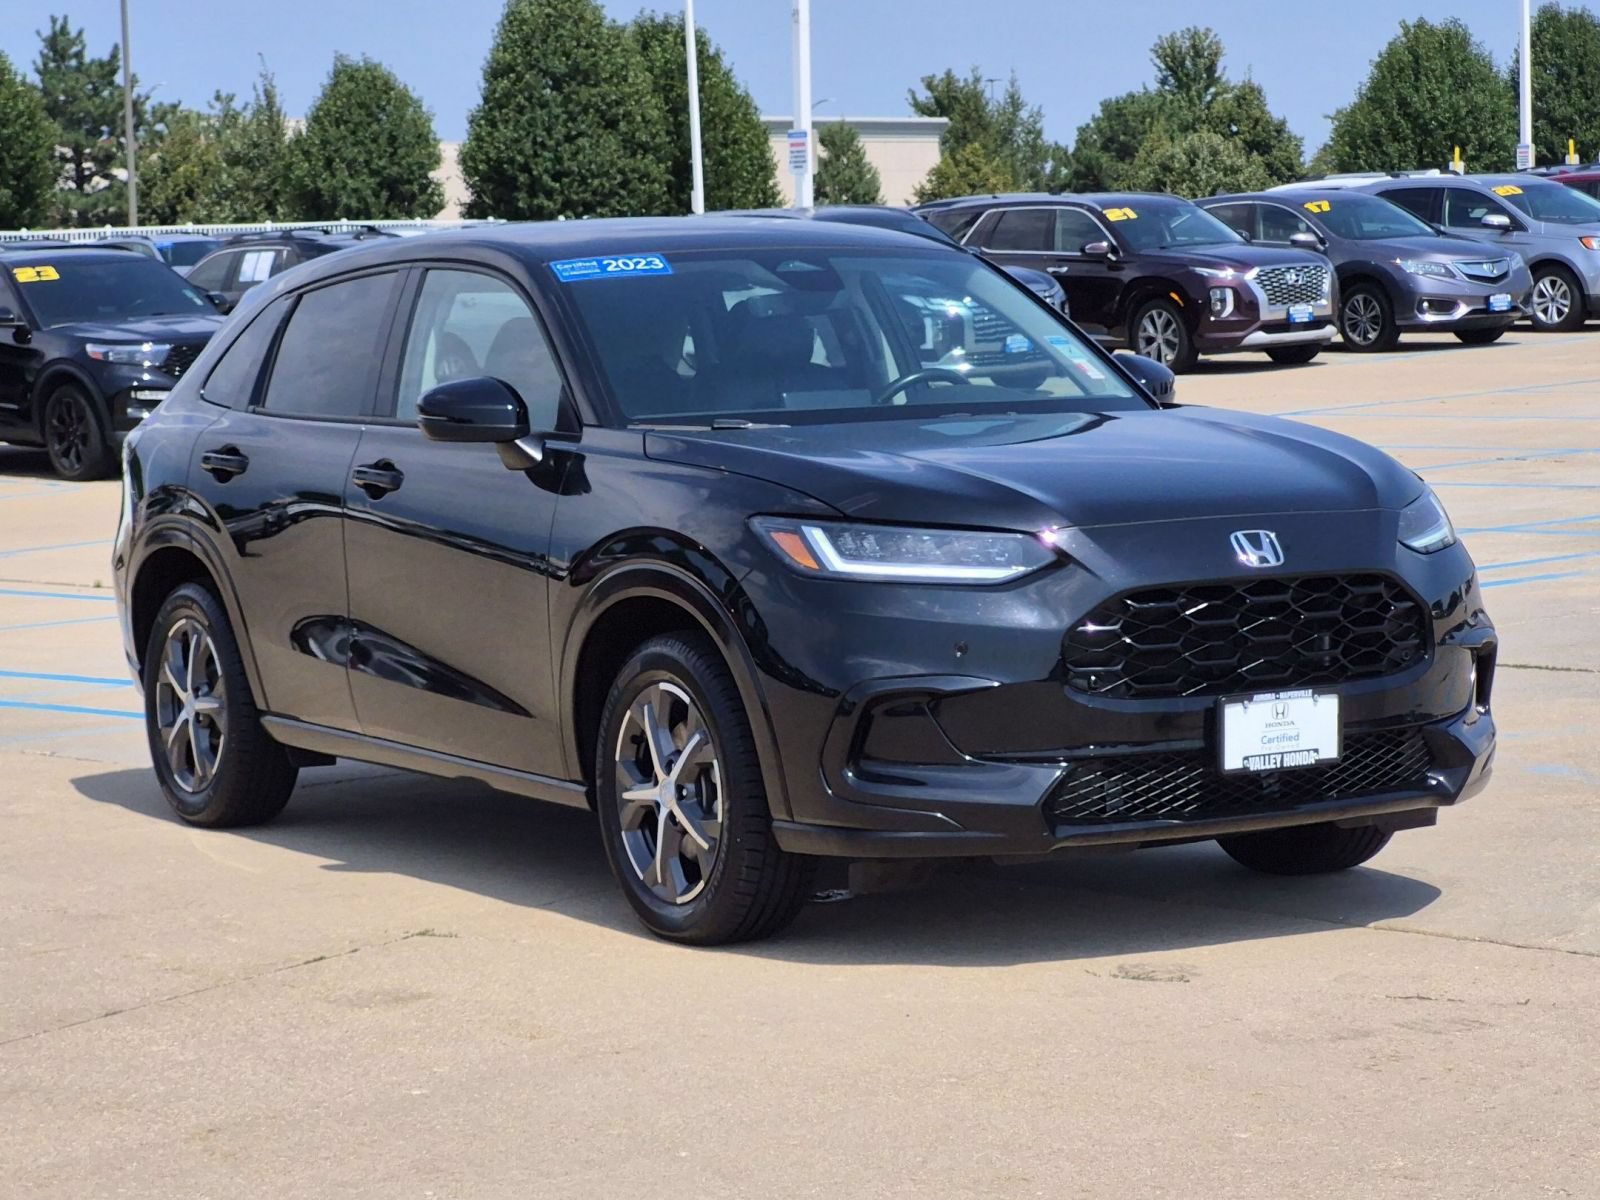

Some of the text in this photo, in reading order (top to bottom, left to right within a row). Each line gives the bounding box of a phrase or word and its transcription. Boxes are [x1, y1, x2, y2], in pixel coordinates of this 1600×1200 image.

[1303, 199, 1331, 213] 17
[1102, 207, 1138, 222] 21
[602, 257, 664, 271] 2023
[12, 265, 61, 283] 23
[1265, 720, 1295, 729] HONDA
[1261, 732, 1300, 745] Certified
[1248, 750, 1315, 771] VALLEY HONDA
